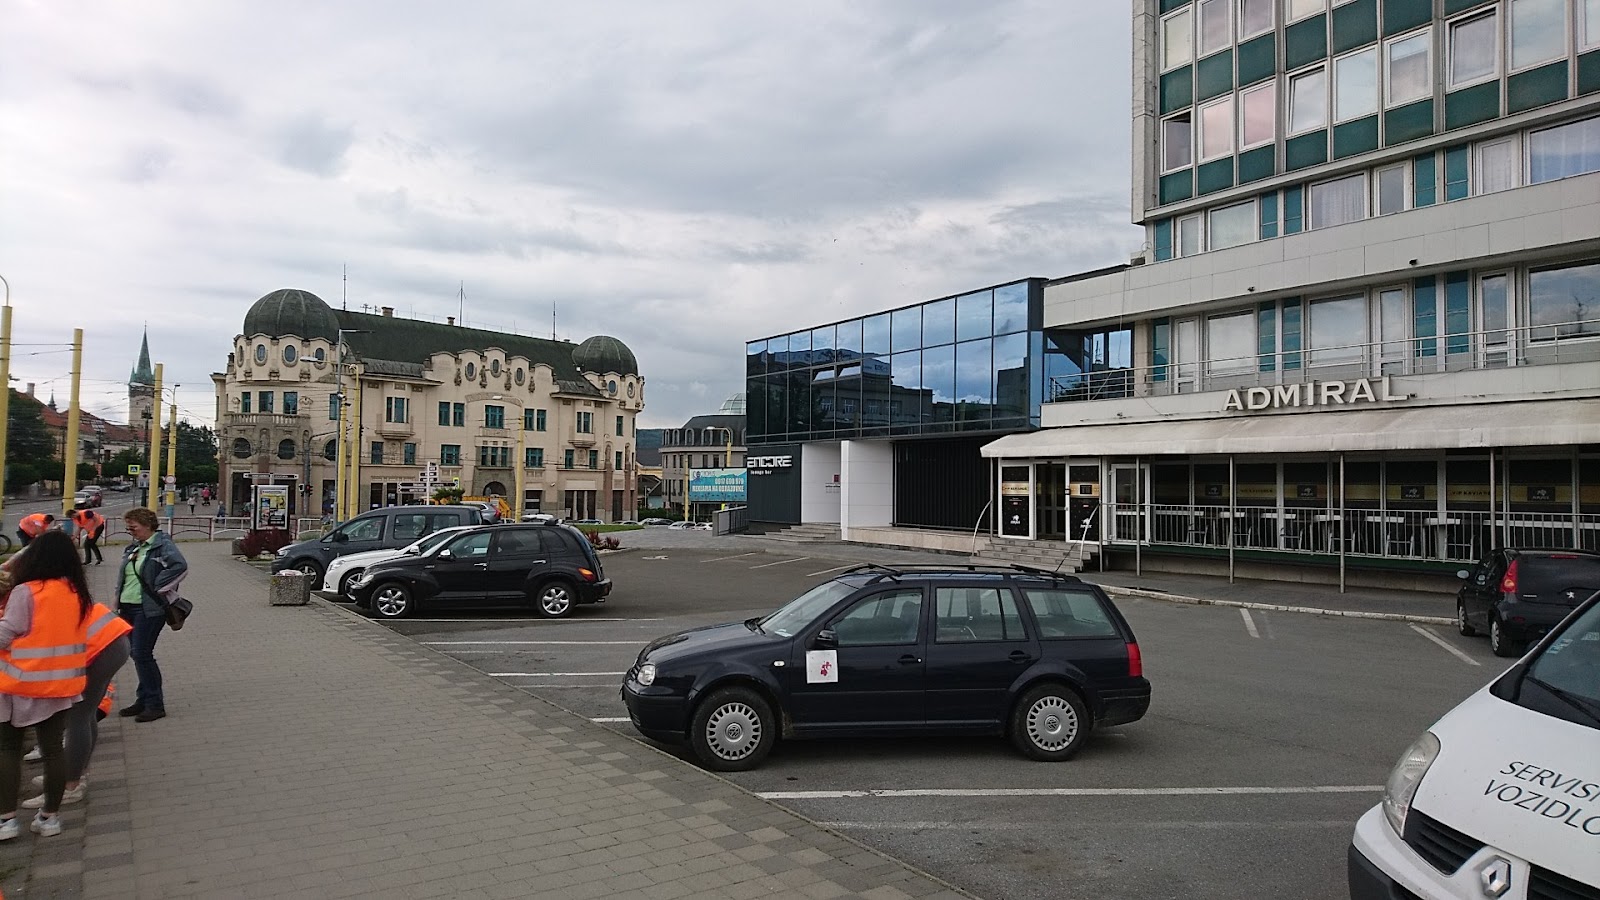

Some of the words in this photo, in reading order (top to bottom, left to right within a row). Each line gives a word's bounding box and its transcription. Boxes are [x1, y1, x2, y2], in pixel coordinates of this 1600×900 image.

[1223, 377, 1408, 411] ADMIRAL
[747, 456, 792, 468] ENCORE
[1484, 779, 1600, 835] VOZIDLO
